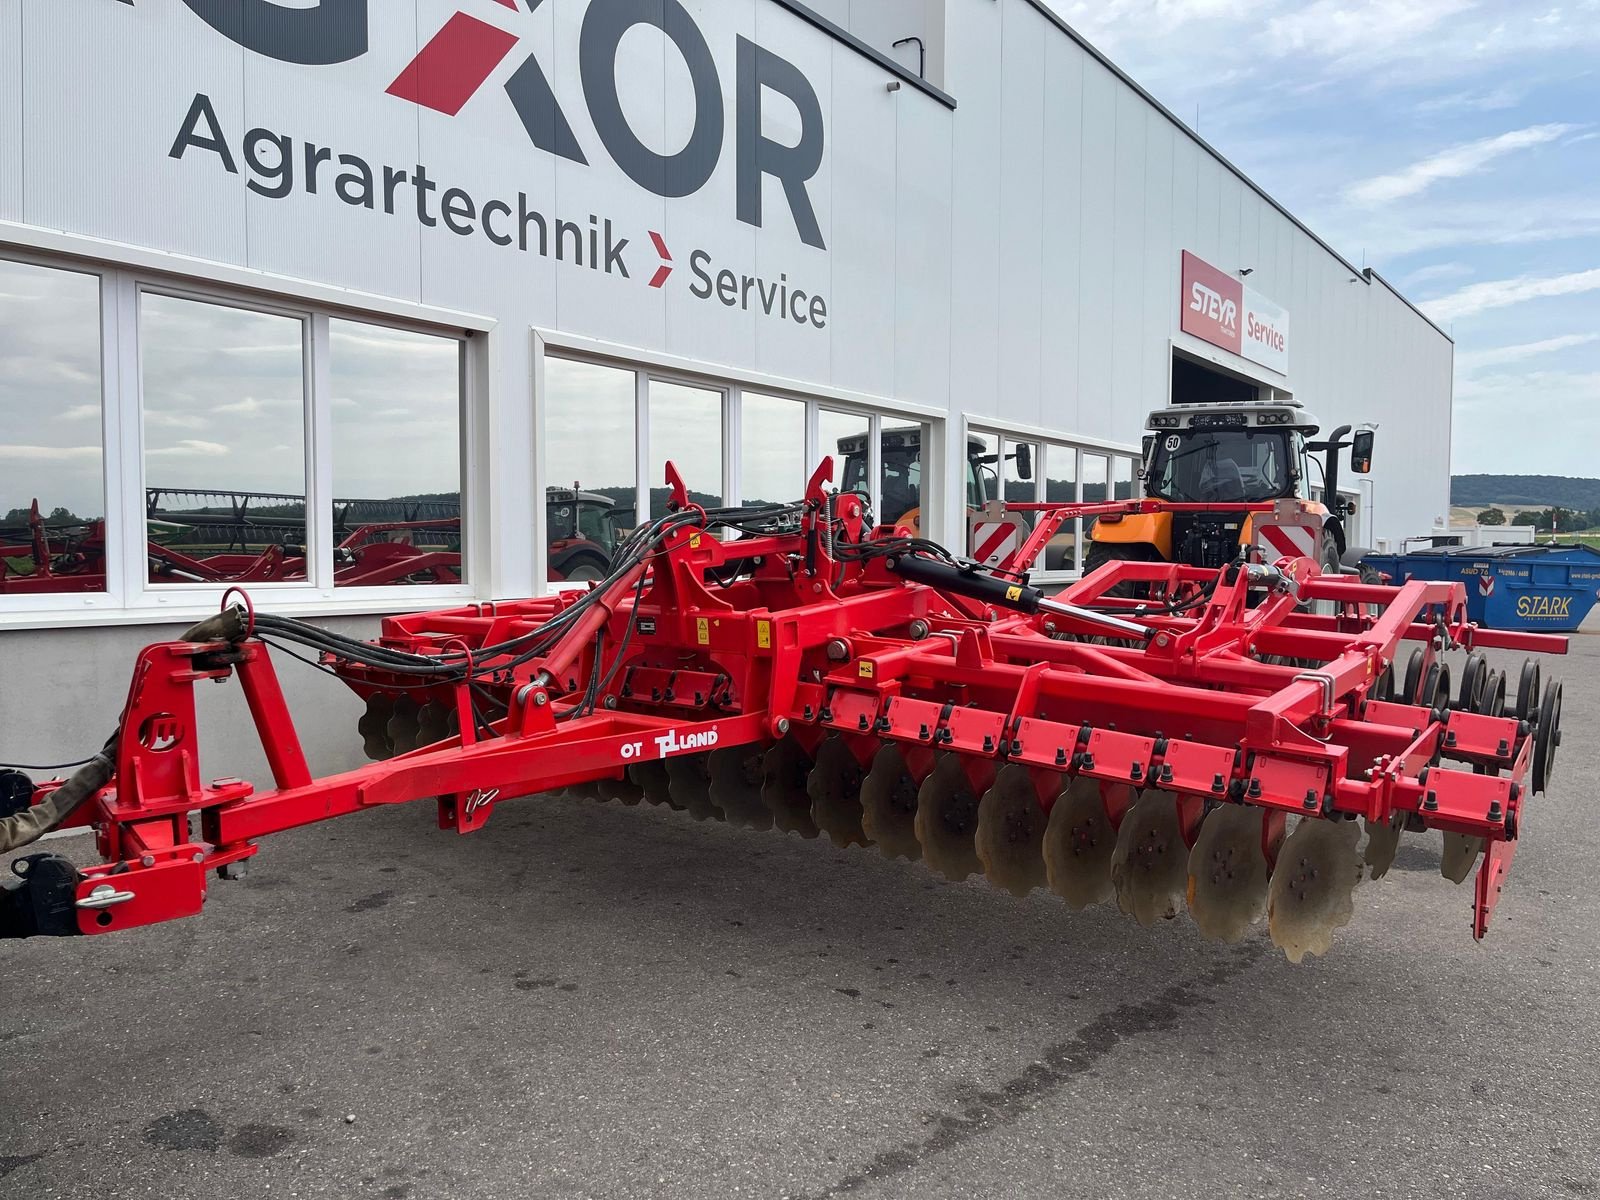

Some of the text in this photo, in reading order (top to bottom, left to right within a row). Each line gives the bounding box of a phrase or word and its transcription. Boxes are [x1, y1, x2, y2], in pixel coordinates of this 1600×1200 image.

[168, 92, 828, 330] Agrartechnik Service
[1189, 281, 1237, 330] STEYR
[1247, 311, 1284, 352] Service
[1167, 437, 1179, 449] 50
[1516, 595, 1573, 616] STARK
[620, 742, 643, 759] OT
